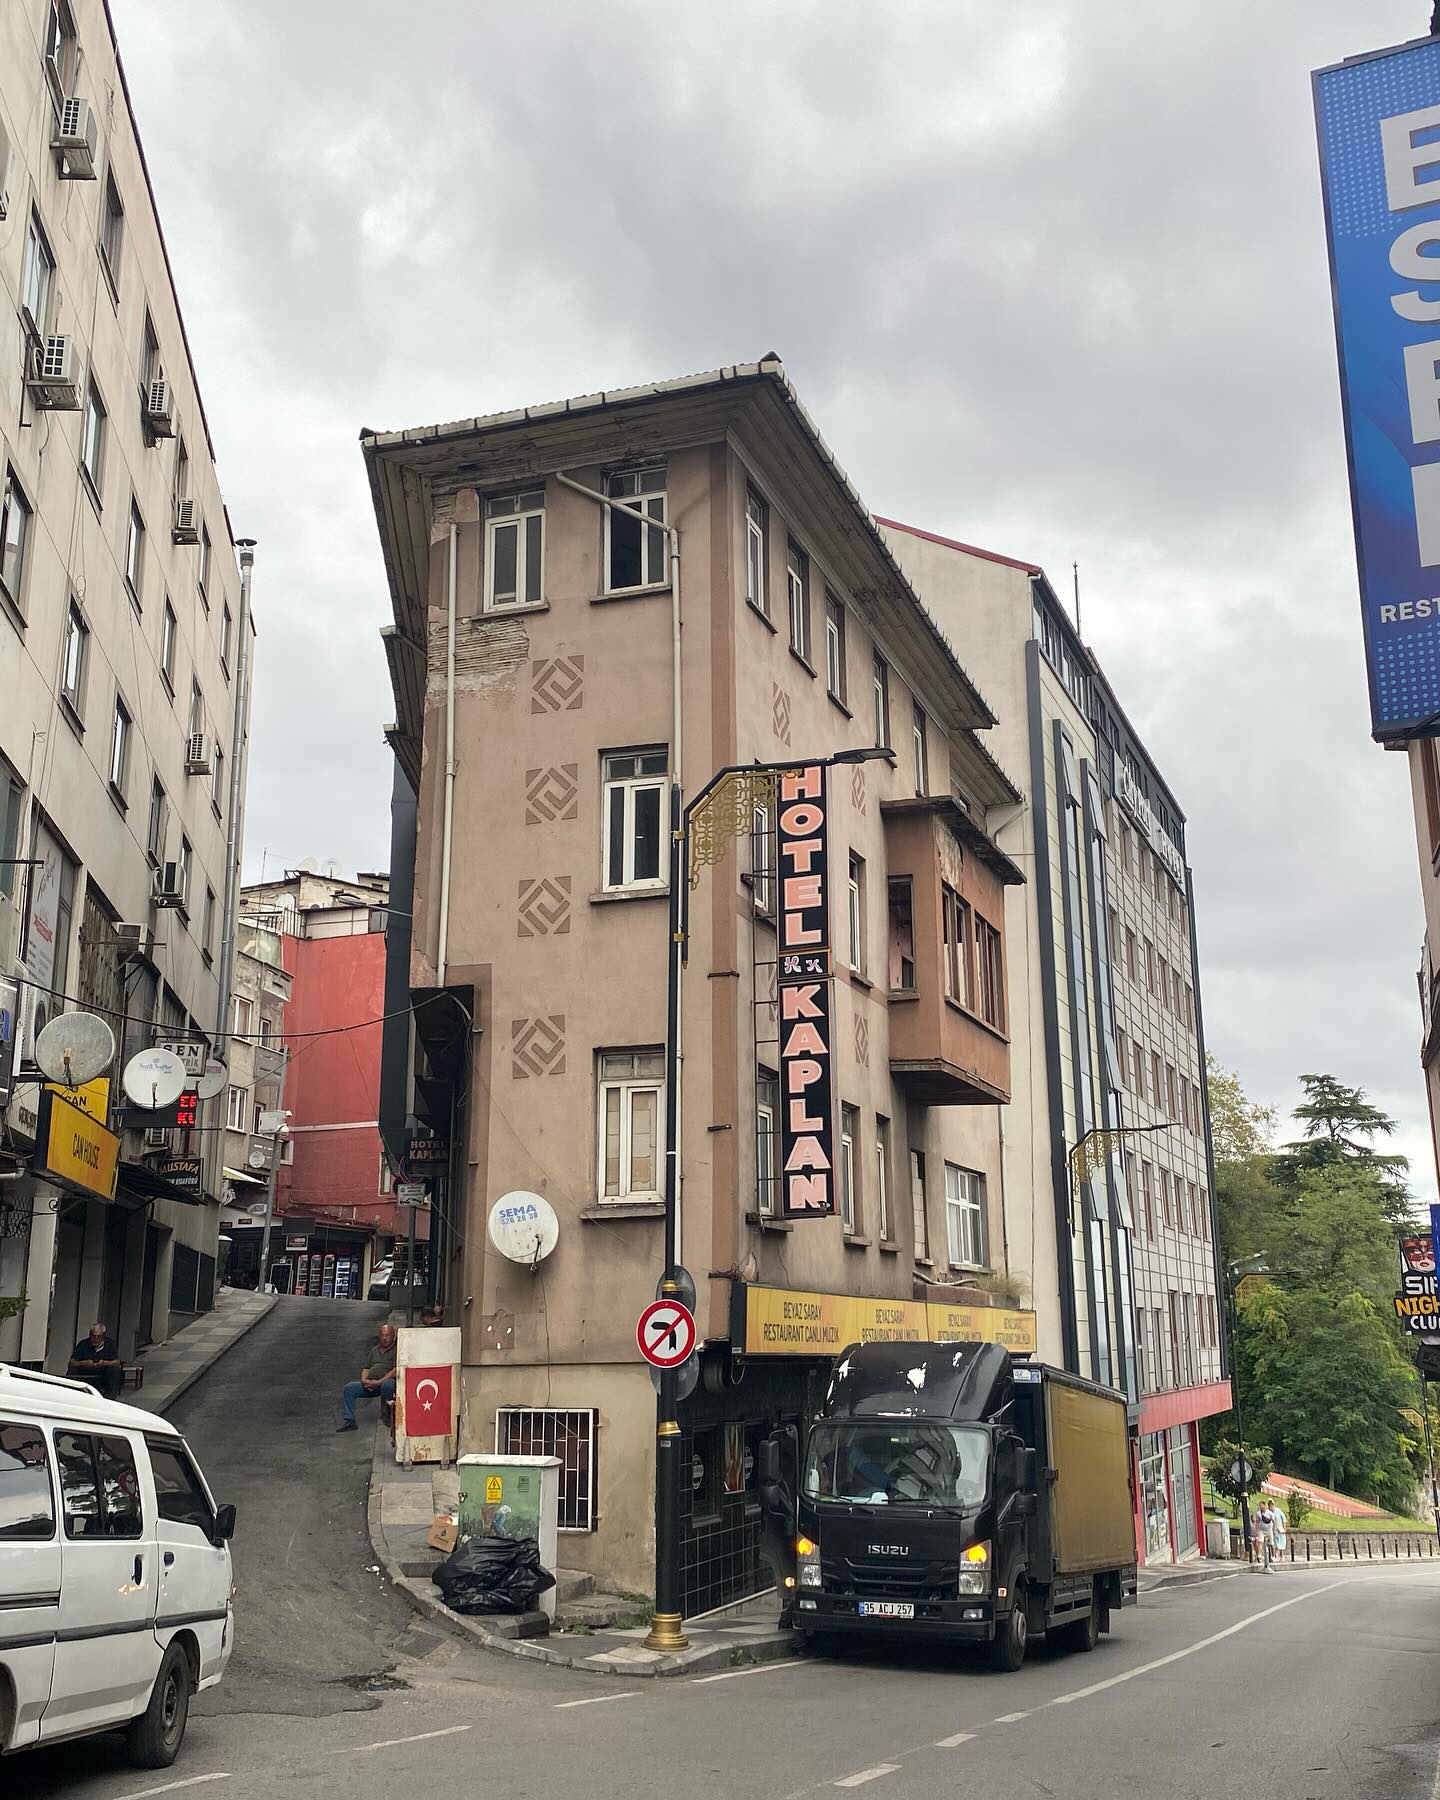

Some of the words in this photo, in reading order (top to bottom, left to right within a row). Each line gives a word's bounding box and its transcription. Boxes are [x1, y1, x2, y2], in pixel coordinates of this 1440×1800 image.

[780, 766, 824, 946] HOTEL
[782, 984, 831, 1210] KAPLAN
[411, 1140, 446, 1149] HOTEL
[409, 1150, 449, 1160] KAPLAN
[499, 1204, 536, 1218] SEMA
[784, 1302, 802, 1320] BEYAZ
[804, 1303, 822, 1321] SARAY
[764, 1323, 804, 1341] RESTAURANT
[868, 1545, 909, 1556] ISUZU
[864, 1603, 875, 1613] 35
[879, 1603, 894, 1614] ACJ
[897, 1604, 912, 1615] 257
